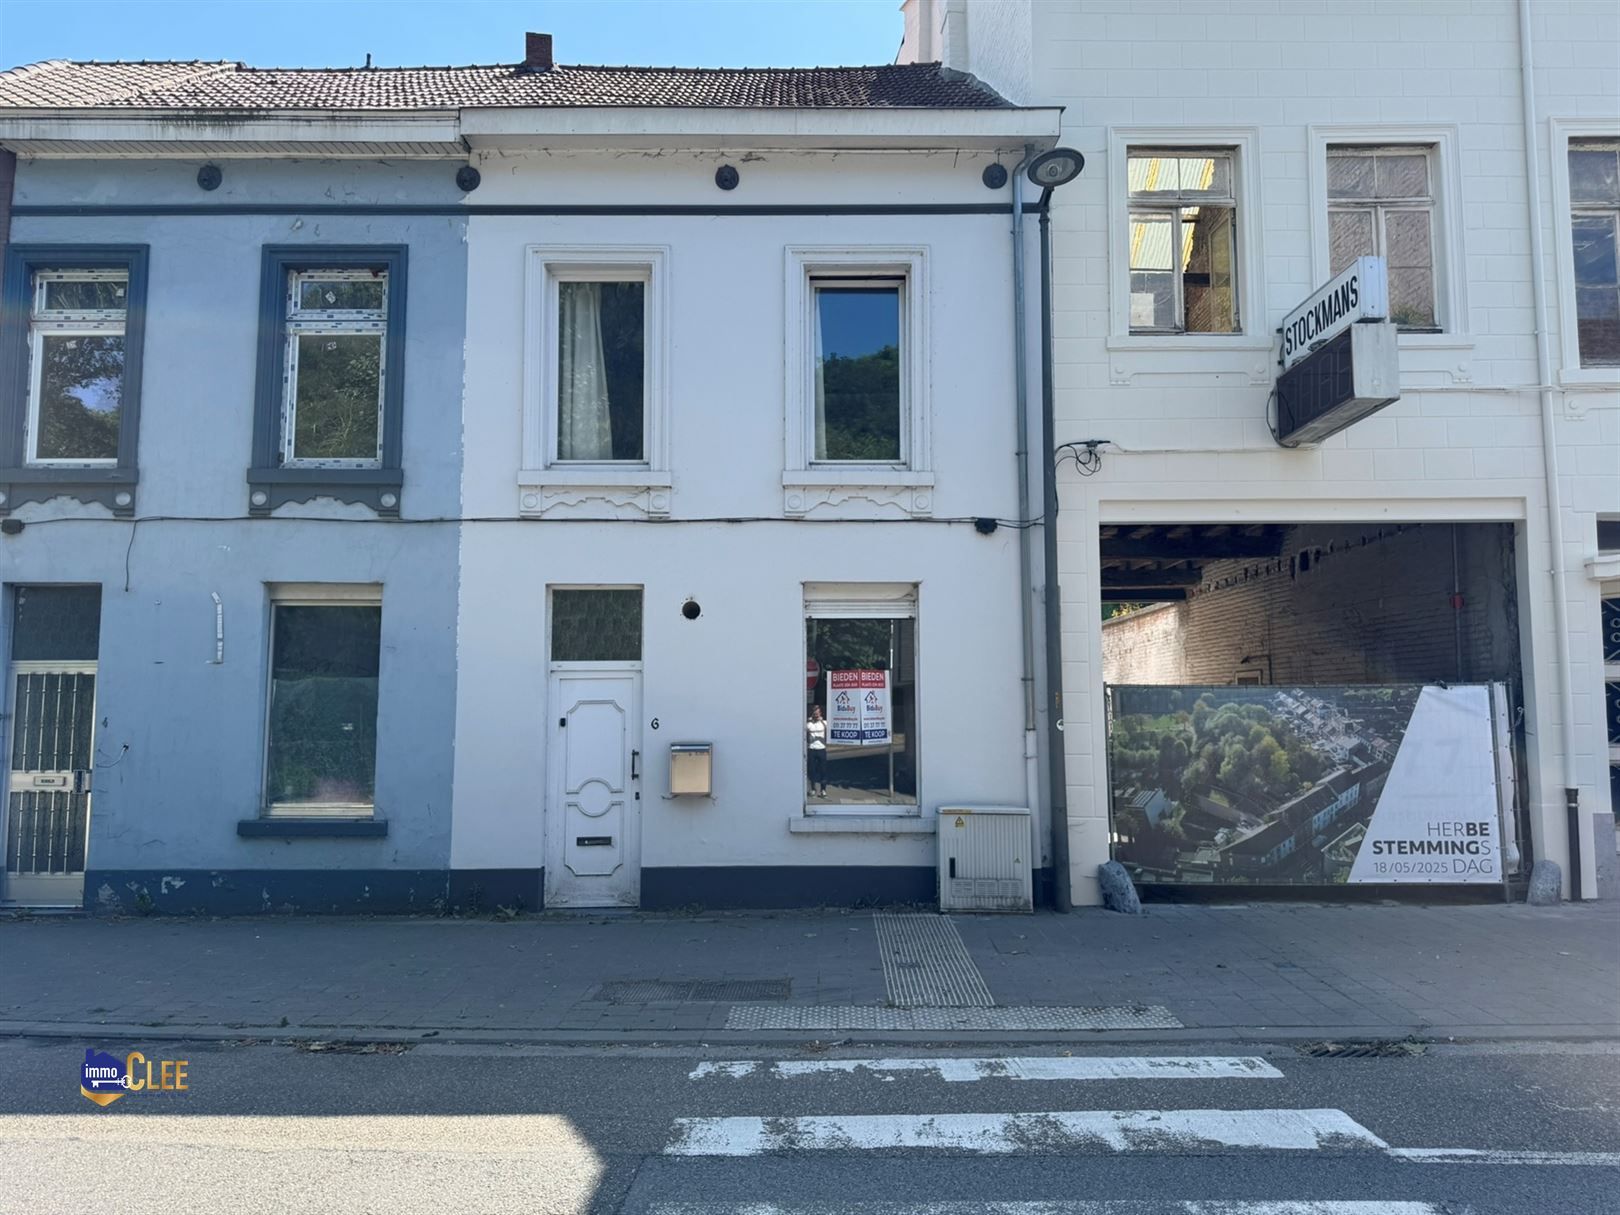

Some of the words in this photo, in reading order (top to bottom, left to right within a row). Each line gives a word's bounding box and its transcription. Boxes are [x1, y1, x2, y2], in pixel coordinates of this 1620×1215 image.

[1285, 275, 1359, 356] STOCKMANS
[833, 673, 858, 682] BIEDEN
[861, 672, 884, 681] BIEDEN
[650, 717, 660, 731] 6
[841, 730, 858, 739] KOOP
[871, 730, 886, 738] KOOP
[1427, 822, 1490, 837] HERBE
[1372, 840, 1491, 856] STEMMINGS
[1373, 862, 1448, 874] 18/05/2025
[1453, 858, 1493, 874] DAG
